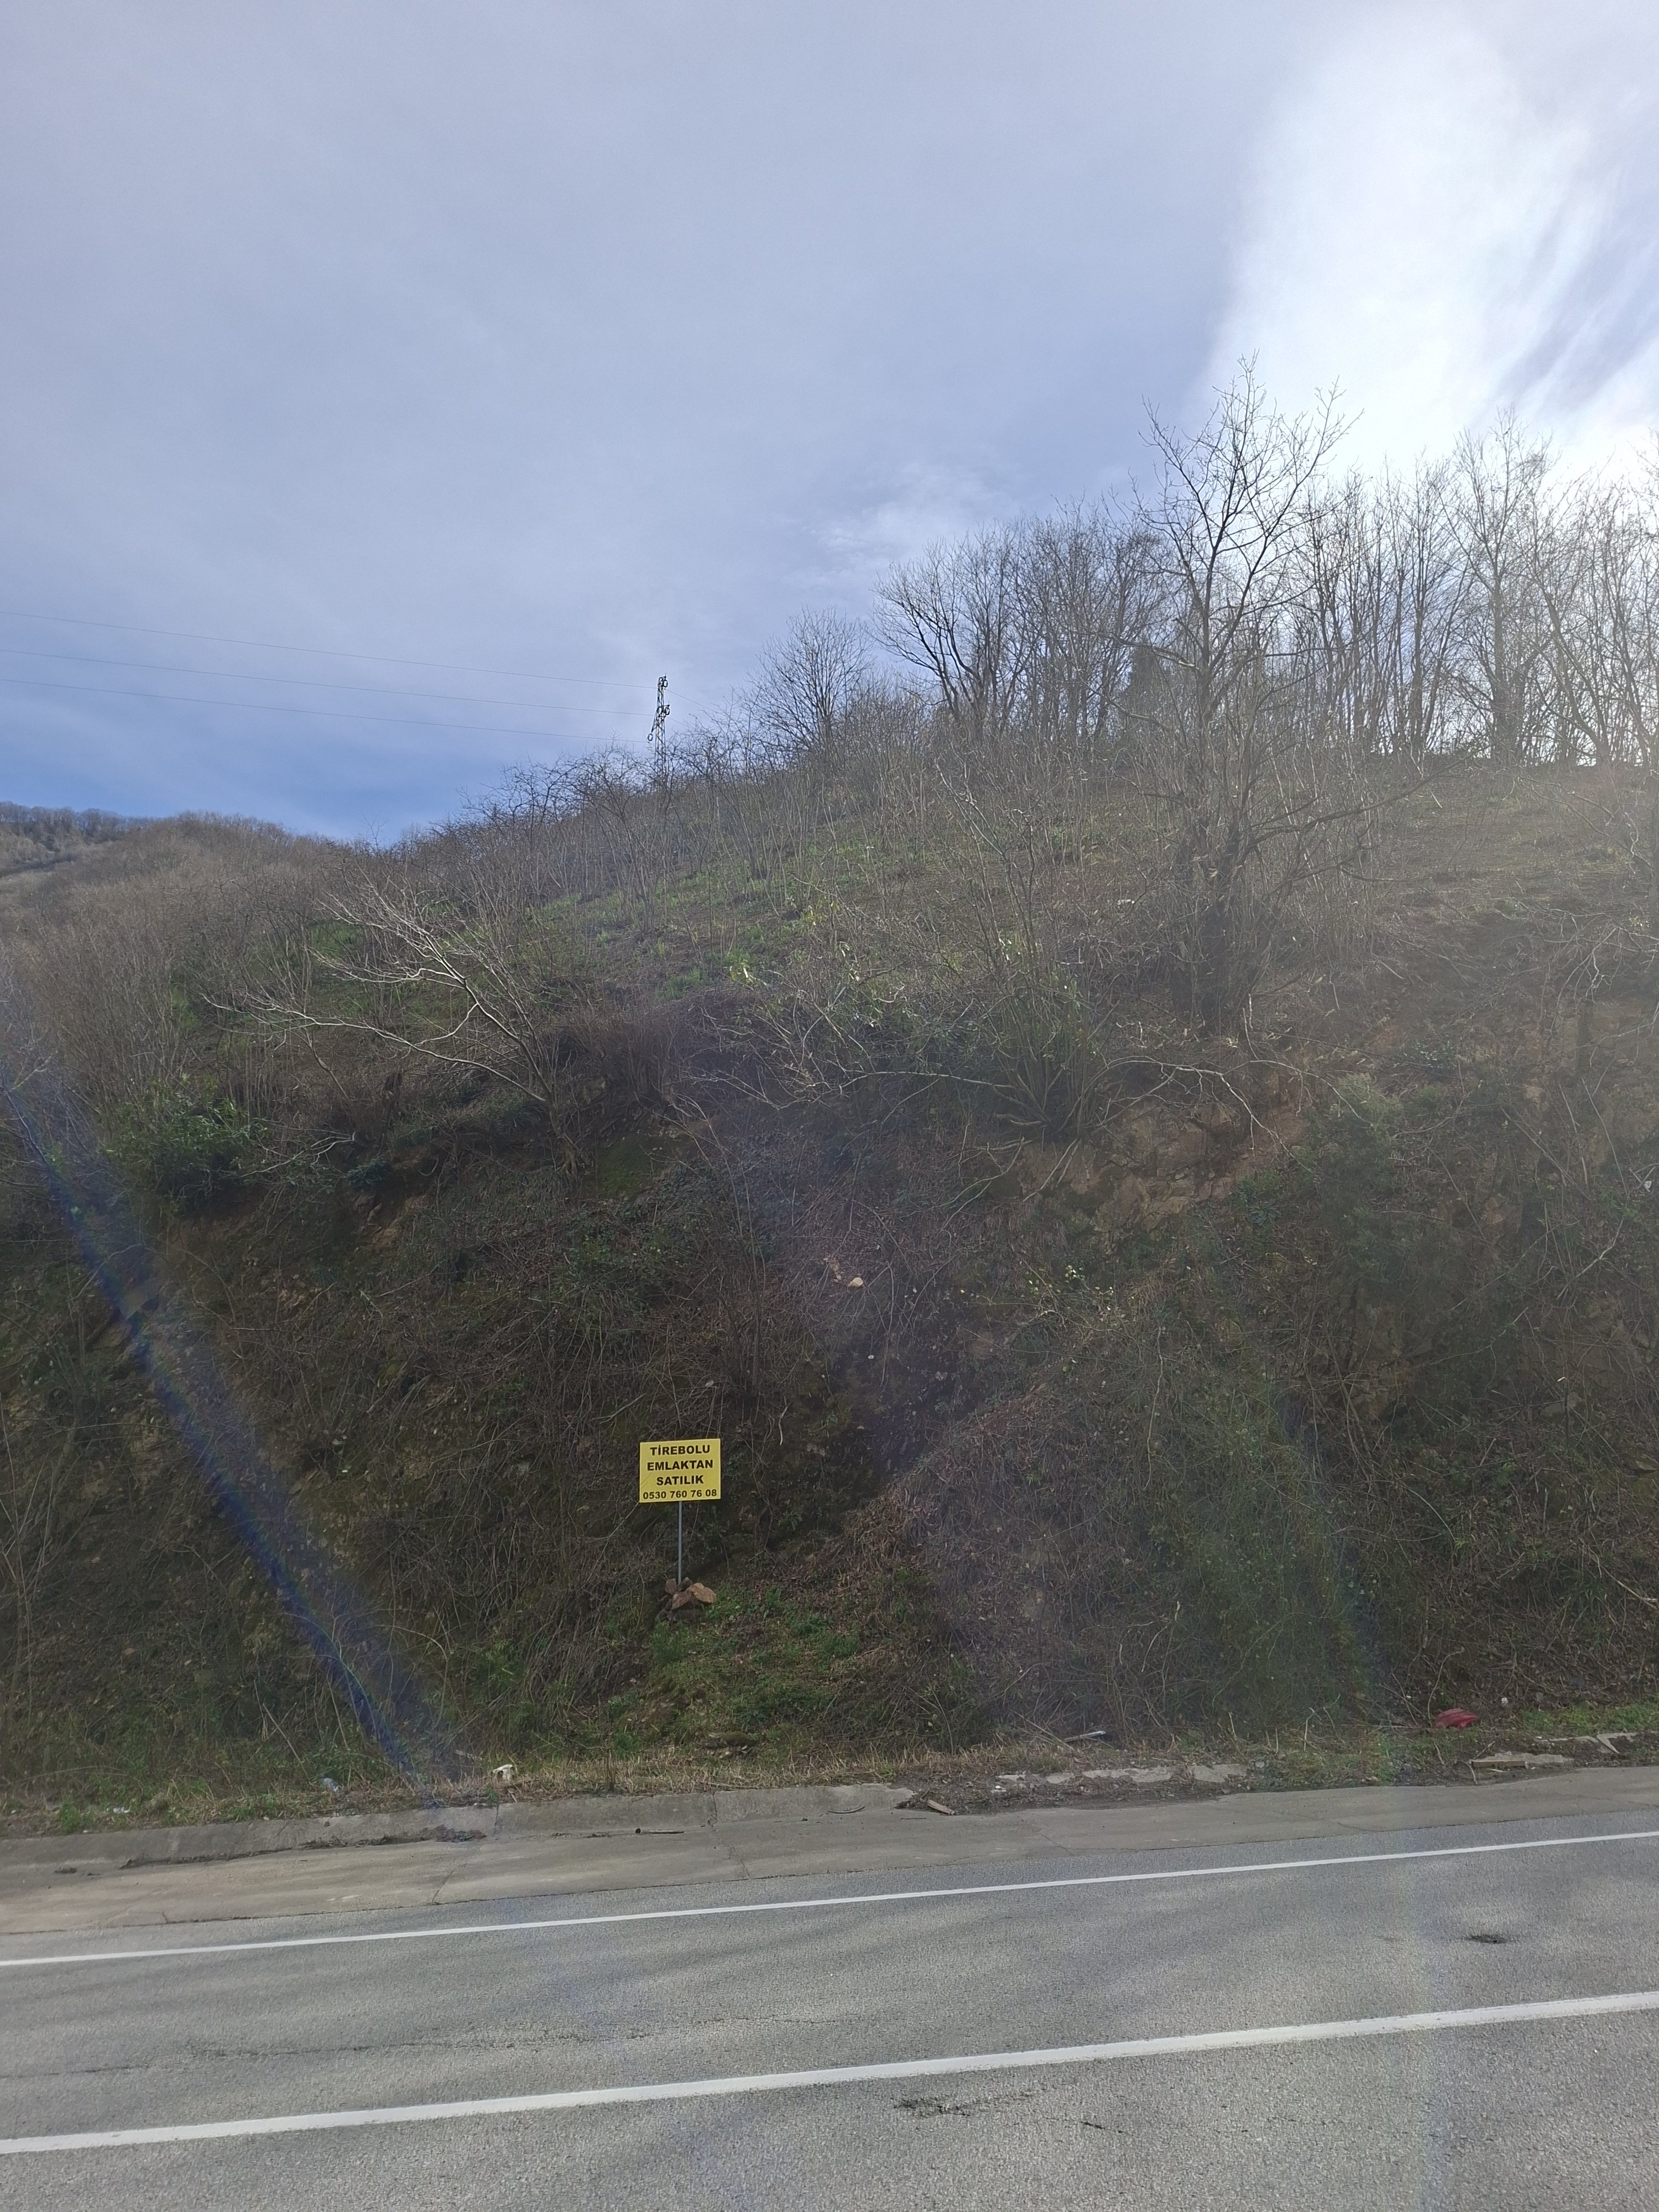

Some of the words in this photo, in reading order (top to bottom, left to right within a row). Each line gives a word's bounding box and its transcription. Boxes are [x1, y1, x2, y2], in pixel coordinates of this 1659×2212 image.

[650, 1444, 710, 1455] TİREBOLU
[647, 1459, 713, 1471] EMLAKTAN
[656, 1475, 704, 1486] SATILIK
